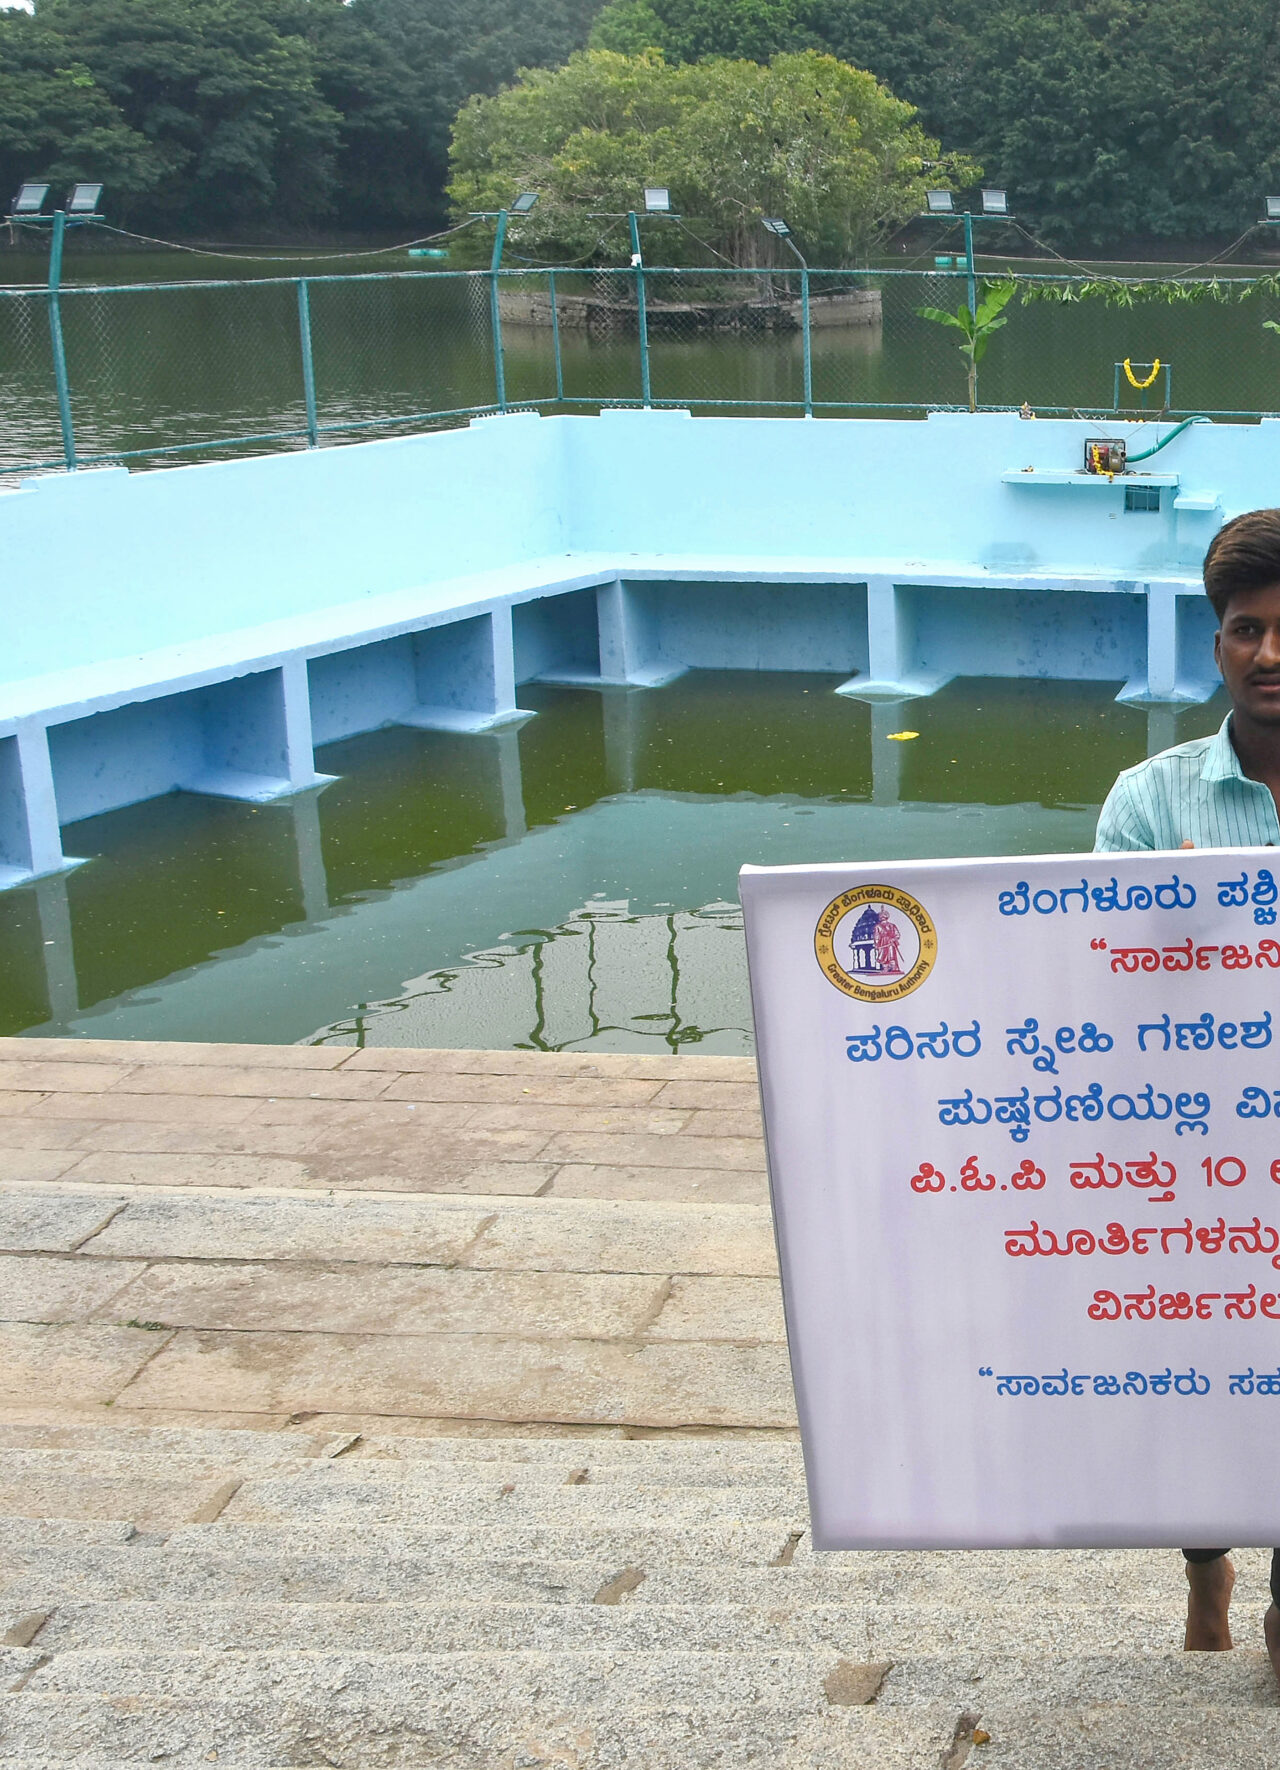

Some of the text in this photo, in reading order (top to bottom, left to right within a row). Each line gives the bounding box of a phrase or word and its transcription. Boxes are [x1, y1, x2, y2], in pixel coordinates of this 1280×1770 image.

[998, 874, 1198, 917] ಬೆಂಗಳೂರು
[827, 960, 930, 1000] Greater Bengaluru Authority
[845, 1019, 982, 1063] ಪರಿಸರ
[1005, 1017, 1115, 1076] ಸ್ನೇಹಿ
[1137, 1010, 1273, 1052] ಗಣೇಶ
[937, 1082, 1211, 1143] ಪುಷ್ಕರಣಿಯಲ್ಲಿ
[1069, 1151, 1177, 1203] ಮತ್ತು
